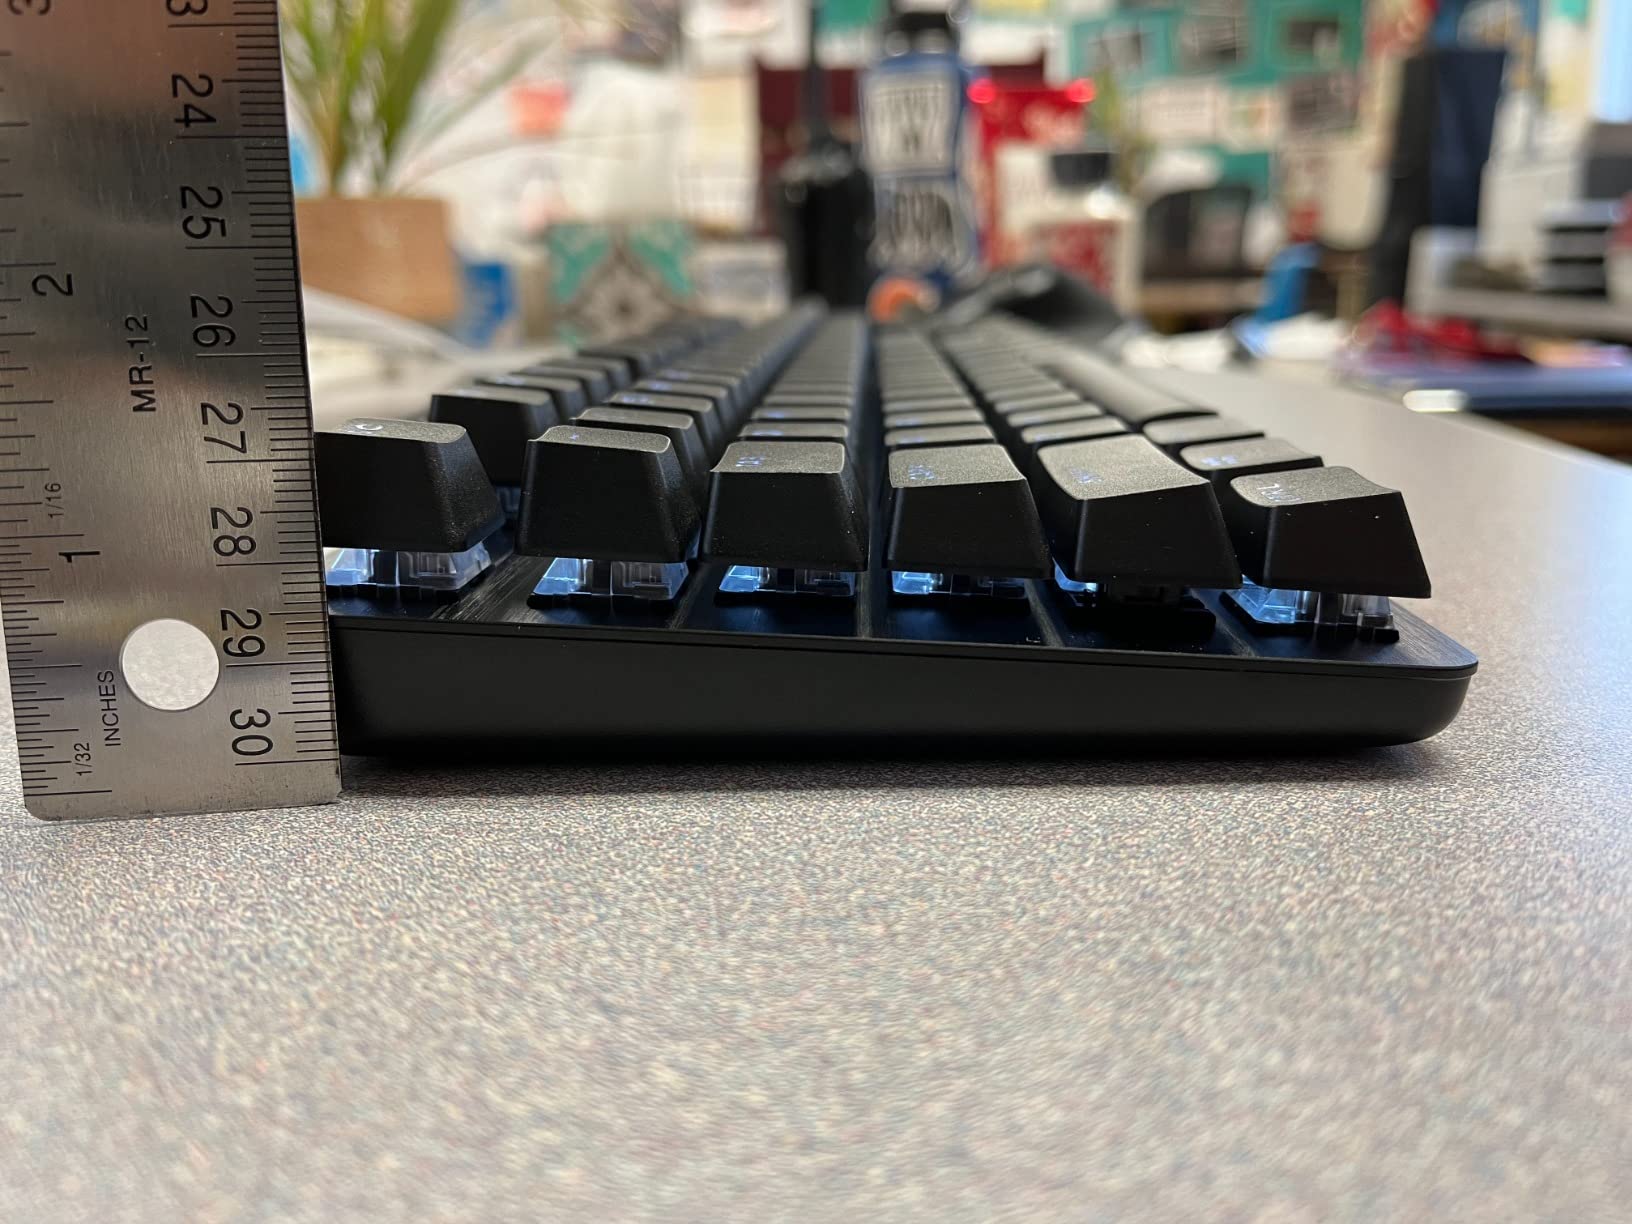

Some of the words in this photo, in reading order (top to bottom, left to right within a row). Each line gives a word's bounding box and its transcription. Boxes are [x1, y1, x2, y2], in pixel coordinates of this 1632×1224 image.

[171, 73, 217, 128] 24
[180, 186, 227, 239] 25
[31, 273, 73, 297] 2
[190, 295, 236, 348] 26
[125, 315, 157, 413] MR-12
[201, 402, 248, 454] 27
[44, 482, 63, 519] 1/16
[58, 550, 100, 563] 1
[210, 506, 257, 557] 28
[220, 608, 266, 658] 29
[97, 669, 122, 747] INCHES
[229, 708, 274, 757] 30
[73, 742, 92, 776] 1/32
